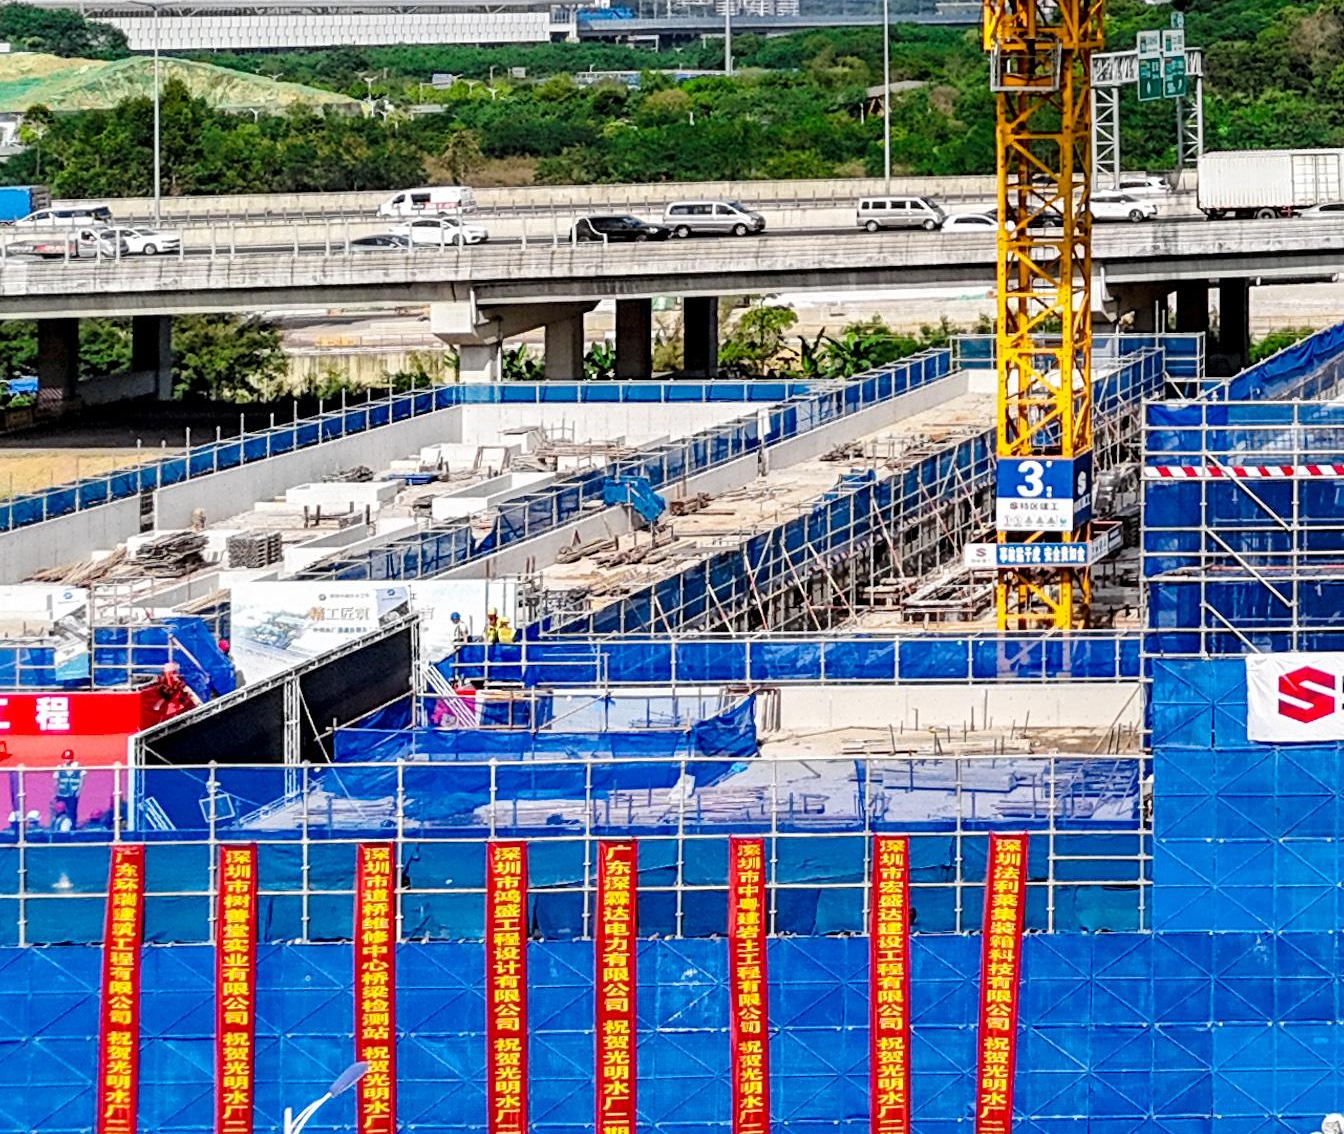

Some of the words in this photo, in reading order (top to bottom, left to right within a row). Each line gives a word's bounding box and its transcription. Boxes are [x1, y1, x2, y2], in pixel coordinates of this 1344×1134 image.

[362, 848, 390, 1040] 深圳市道桥维修中心桥梁检测站
[494, 847, 521, 1031] 深圳市鸿盛工程设计有限公司
[878, 840, 905, 1030] 深圳市宏盛达建设工程有限公司
[105, 1031, 133, 1134] 祝贺光明水厂二
[877, 1037, 905, 1134] 祝贺光明水厂二
[980, 1037, 1010, 1134] 祝贺光明水厂二
